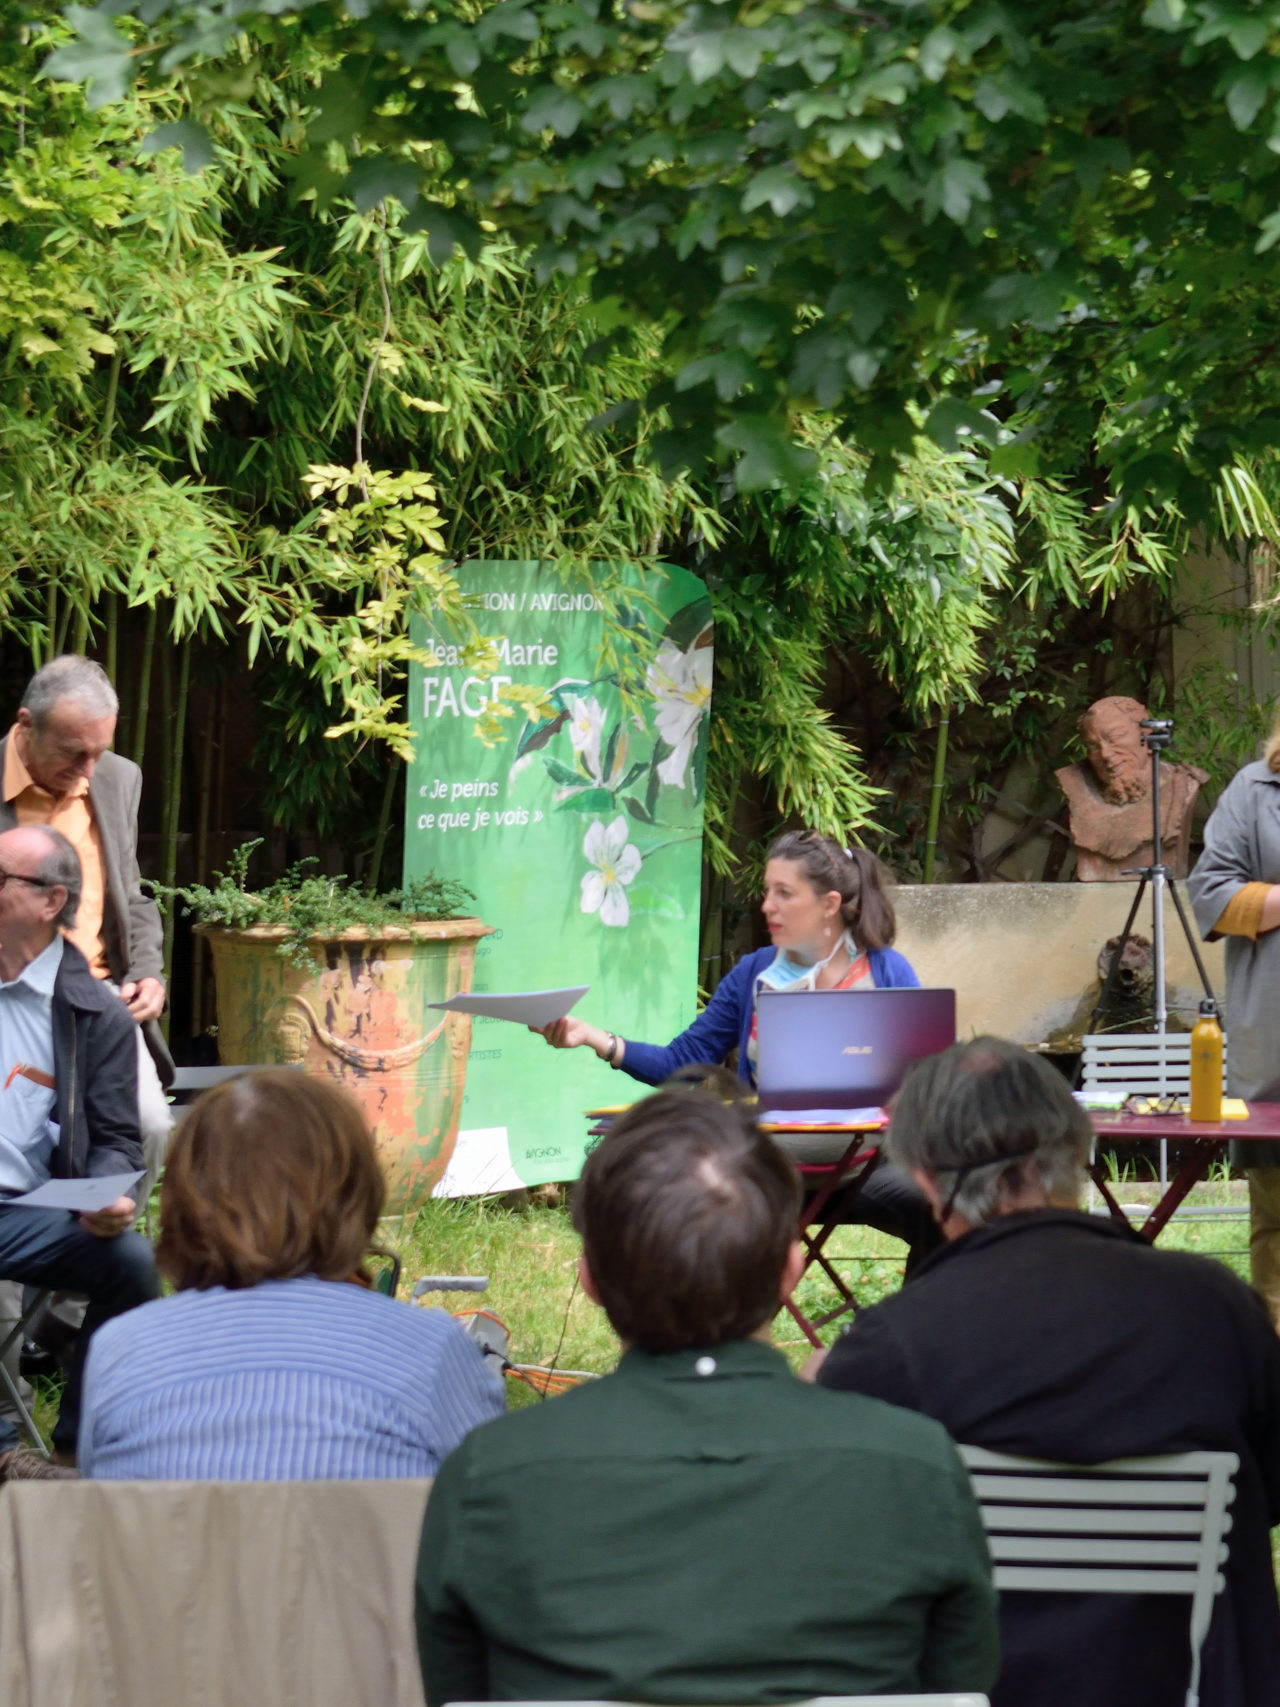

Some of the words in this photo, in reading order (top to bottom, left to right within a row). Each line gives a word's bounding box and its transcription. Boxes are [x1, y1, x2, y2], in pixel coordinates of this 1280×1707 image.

[429, 778, 449, 798] Je
[450, 777, 499, 802] peins
[417, 812, 435, 829] ce
[437, 811, 471, 833] que
[471, 806, 491, 832] je
[495, 805, 530, 826] vois
